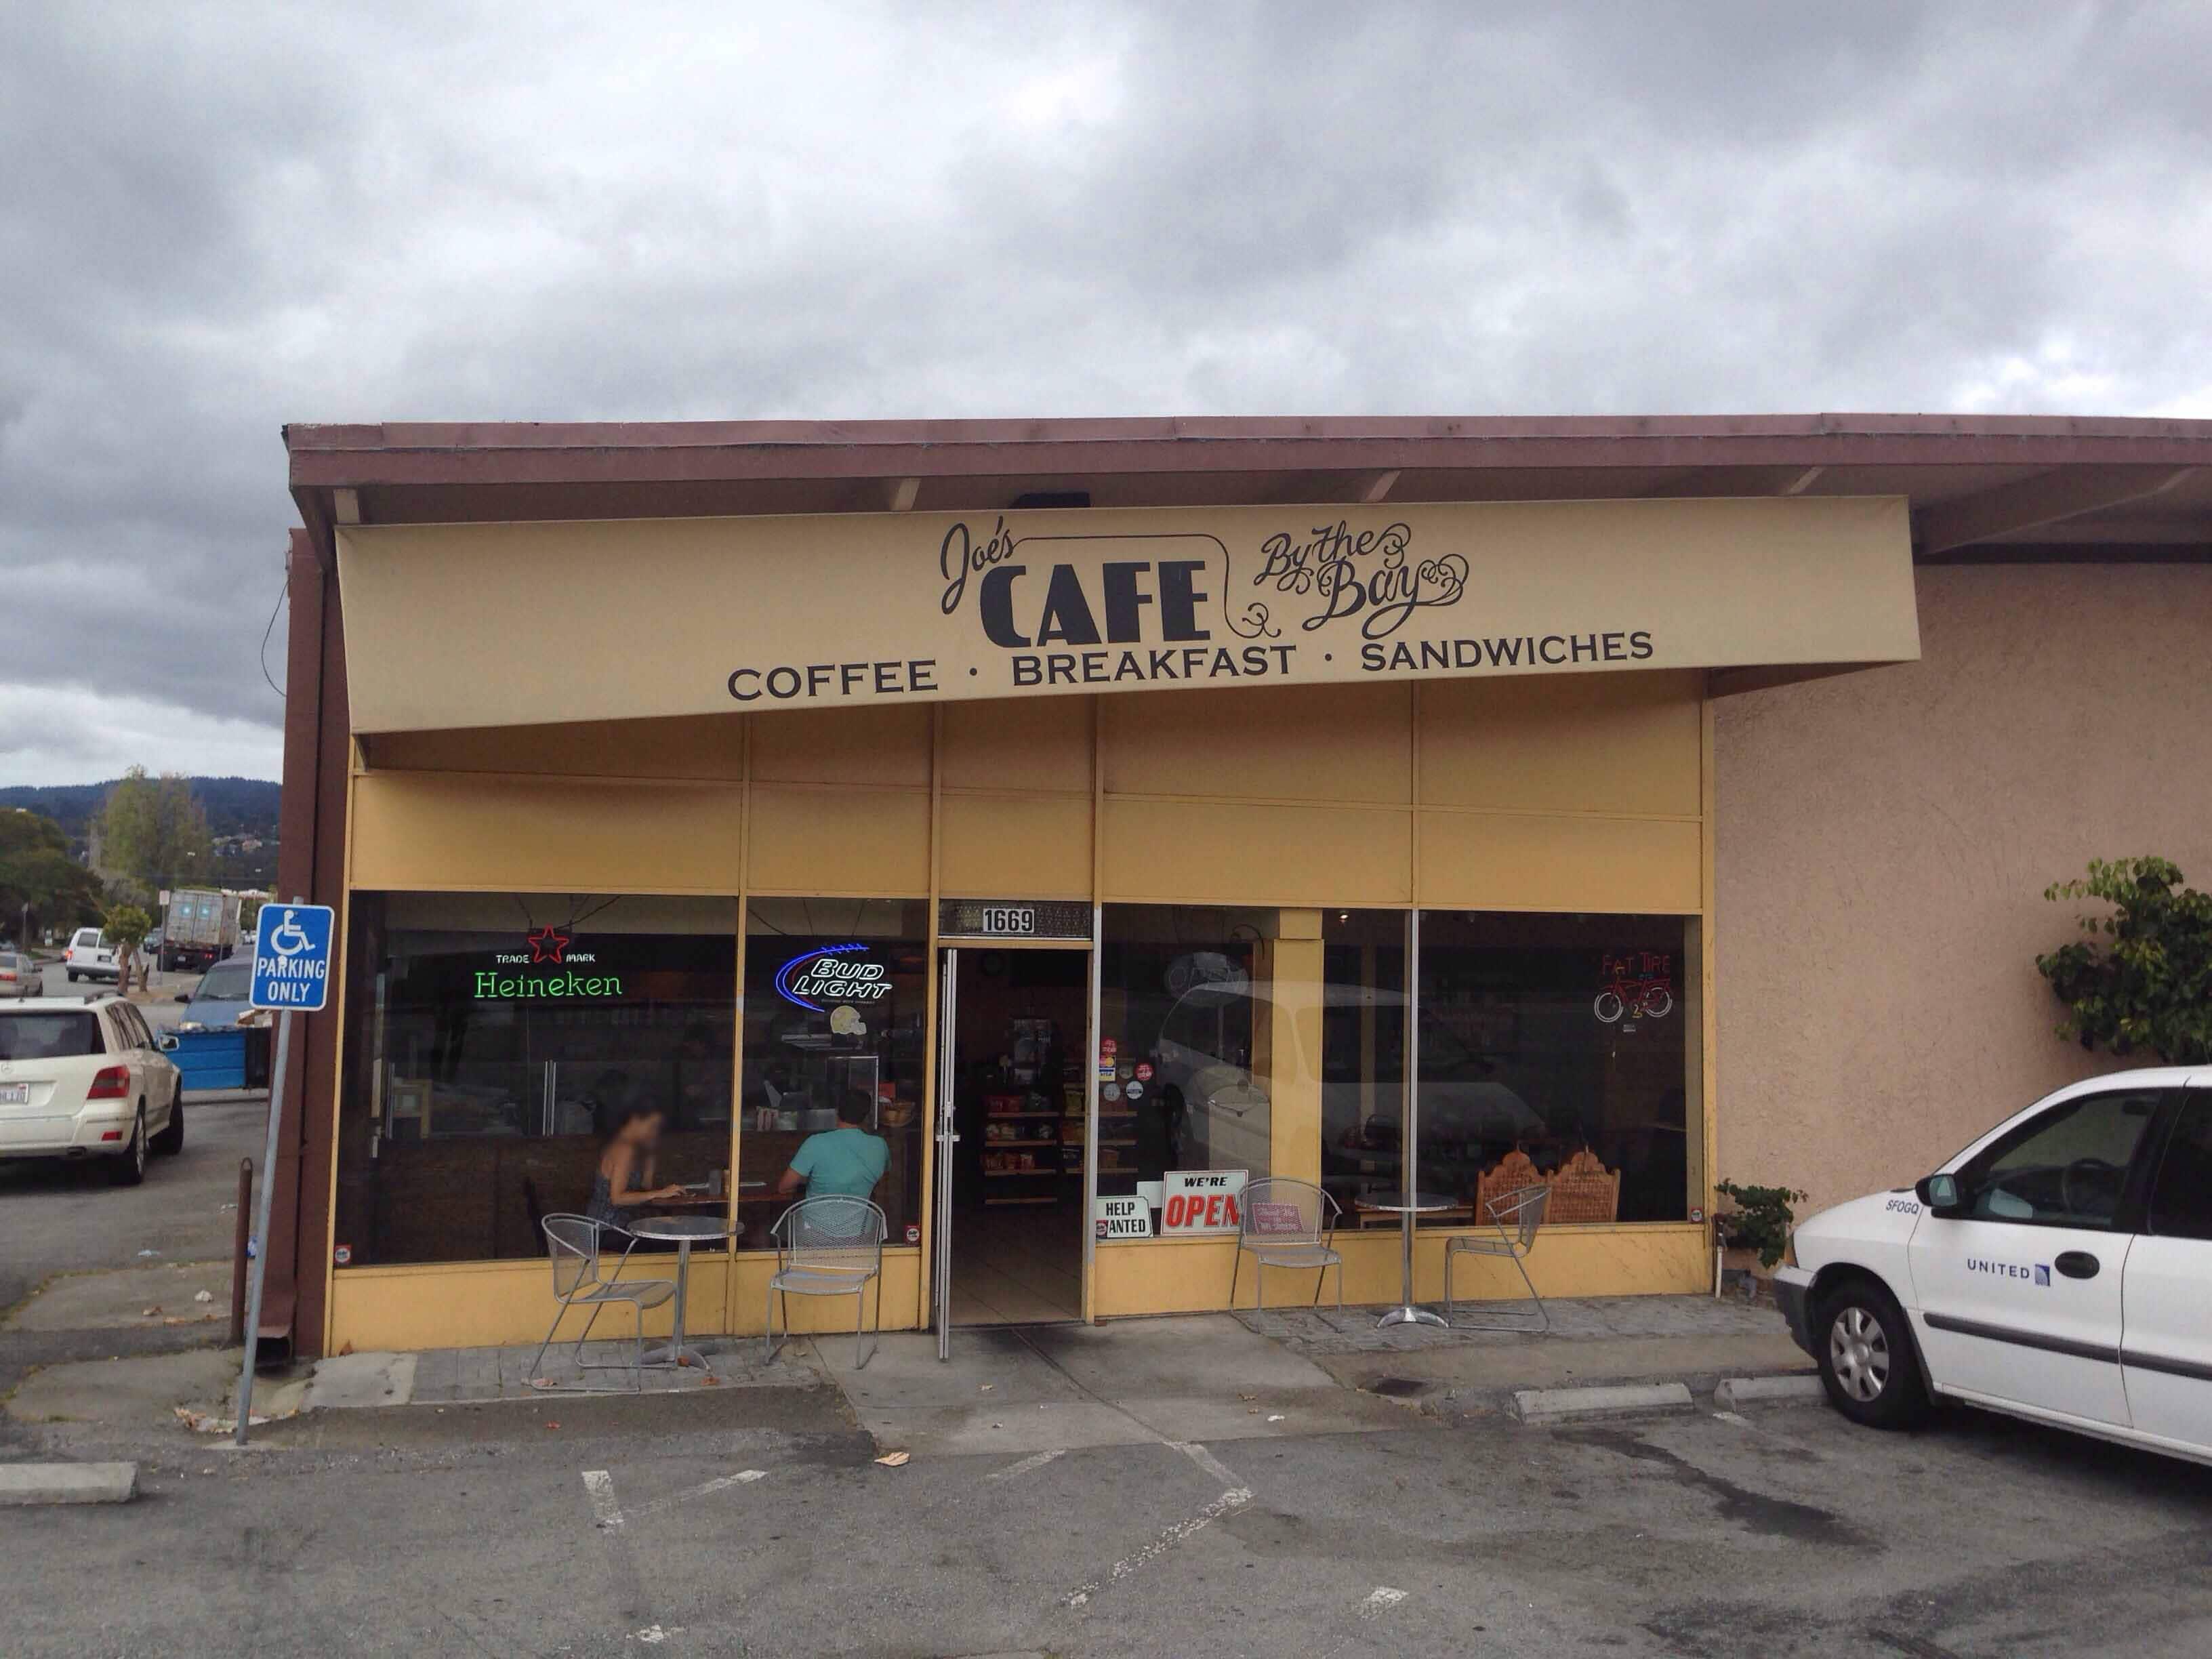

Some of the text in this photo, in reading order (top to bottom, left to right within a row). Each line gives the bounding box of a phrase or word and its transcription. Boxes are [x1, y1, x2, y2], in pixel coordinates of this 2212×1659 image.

[941, 516, 1015, 615] Joe's
[1254, 532, 1315, 594] By
[980, 561, 1210, 647] CAFE
[1303, 553, 1469, 639] Bay
[728, 631, 1654, 701] COFFEE BREAKFAST SANDWICHES
[985, 909, 1033, 932] 1669
[257, 958, 325, 979] PARKING
[496, 954, 596, 964] TRADE MARK
[811, 958, 884, 980] BUD
[268, 981, 310, 1002] ONLY
[474, 971, 623, 998] Heineken
[792, 975, 893, 999] LIGHT
[1184, 1177, 1228, 1187] WE'RE
[1106, 1202, 1135, 1216] HELP
[1165, 1193, 1240, 1228] OPEN
[1107, 1218, 1145, 1233] ANTED
[1967, 1258, 2030, 1279] UNITED
